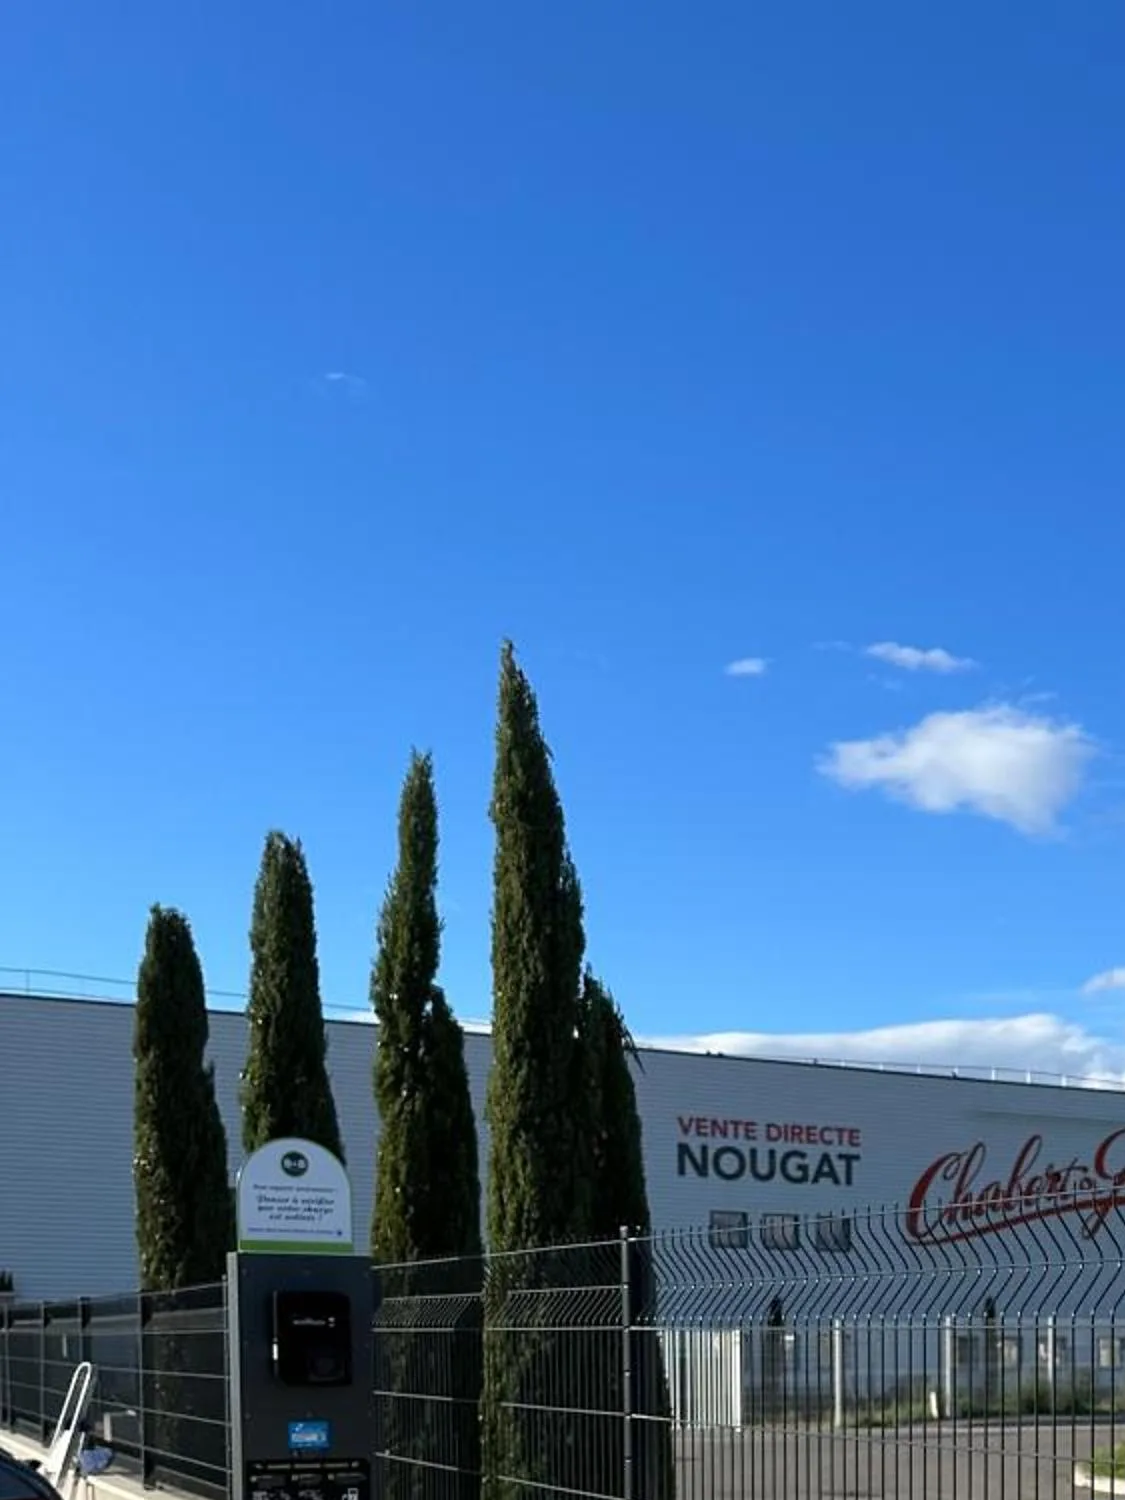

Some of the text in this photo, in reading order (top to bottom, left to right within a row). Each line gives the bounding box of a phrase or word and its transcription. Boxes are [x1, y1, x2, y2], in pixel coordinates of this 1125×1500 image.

[677, 1116, 861, 1147] VENTE DIRECTE
[677, 1142, 861, 1187] NOUGAT
